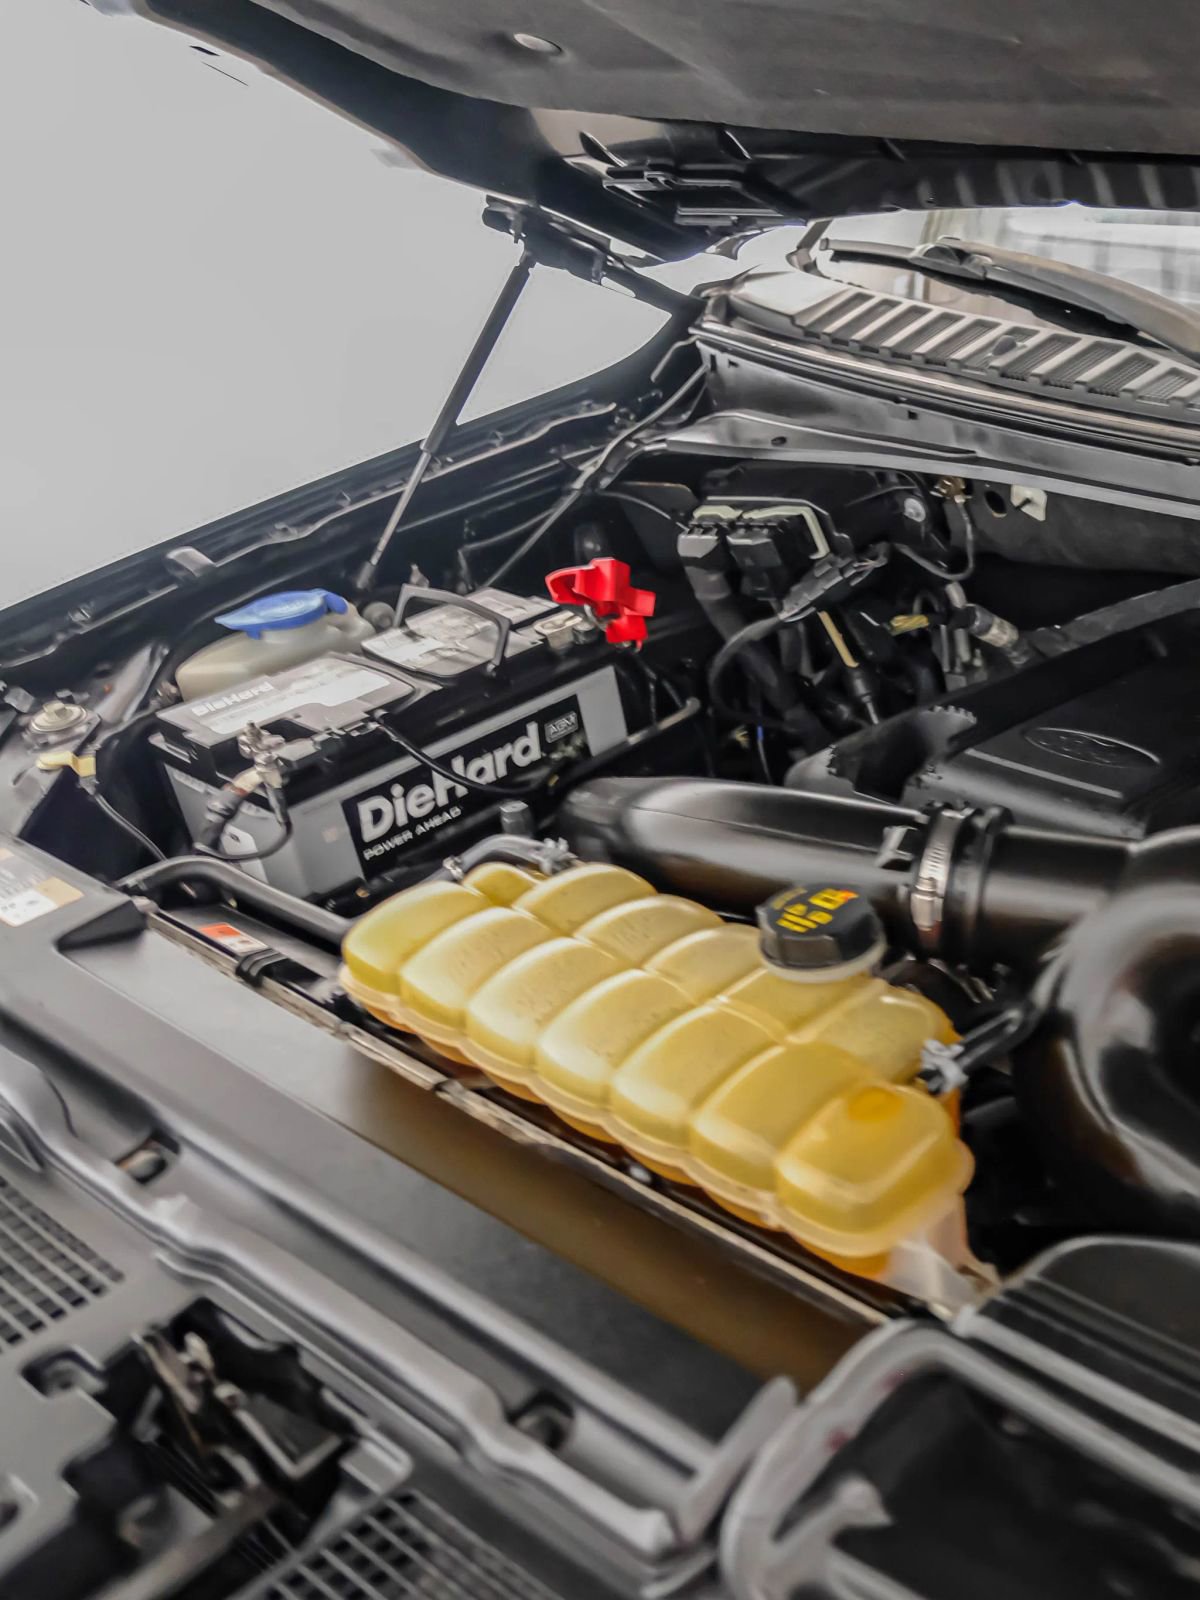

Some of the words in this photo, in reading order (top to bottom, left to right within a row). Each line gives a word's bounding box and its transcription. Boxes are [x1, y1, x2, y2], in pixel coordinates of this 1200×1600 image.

[357, 721, 542, 843] DieHard
[364, 830, 414, 860] POWER
[415, 806, 462, 836] AHEAD
